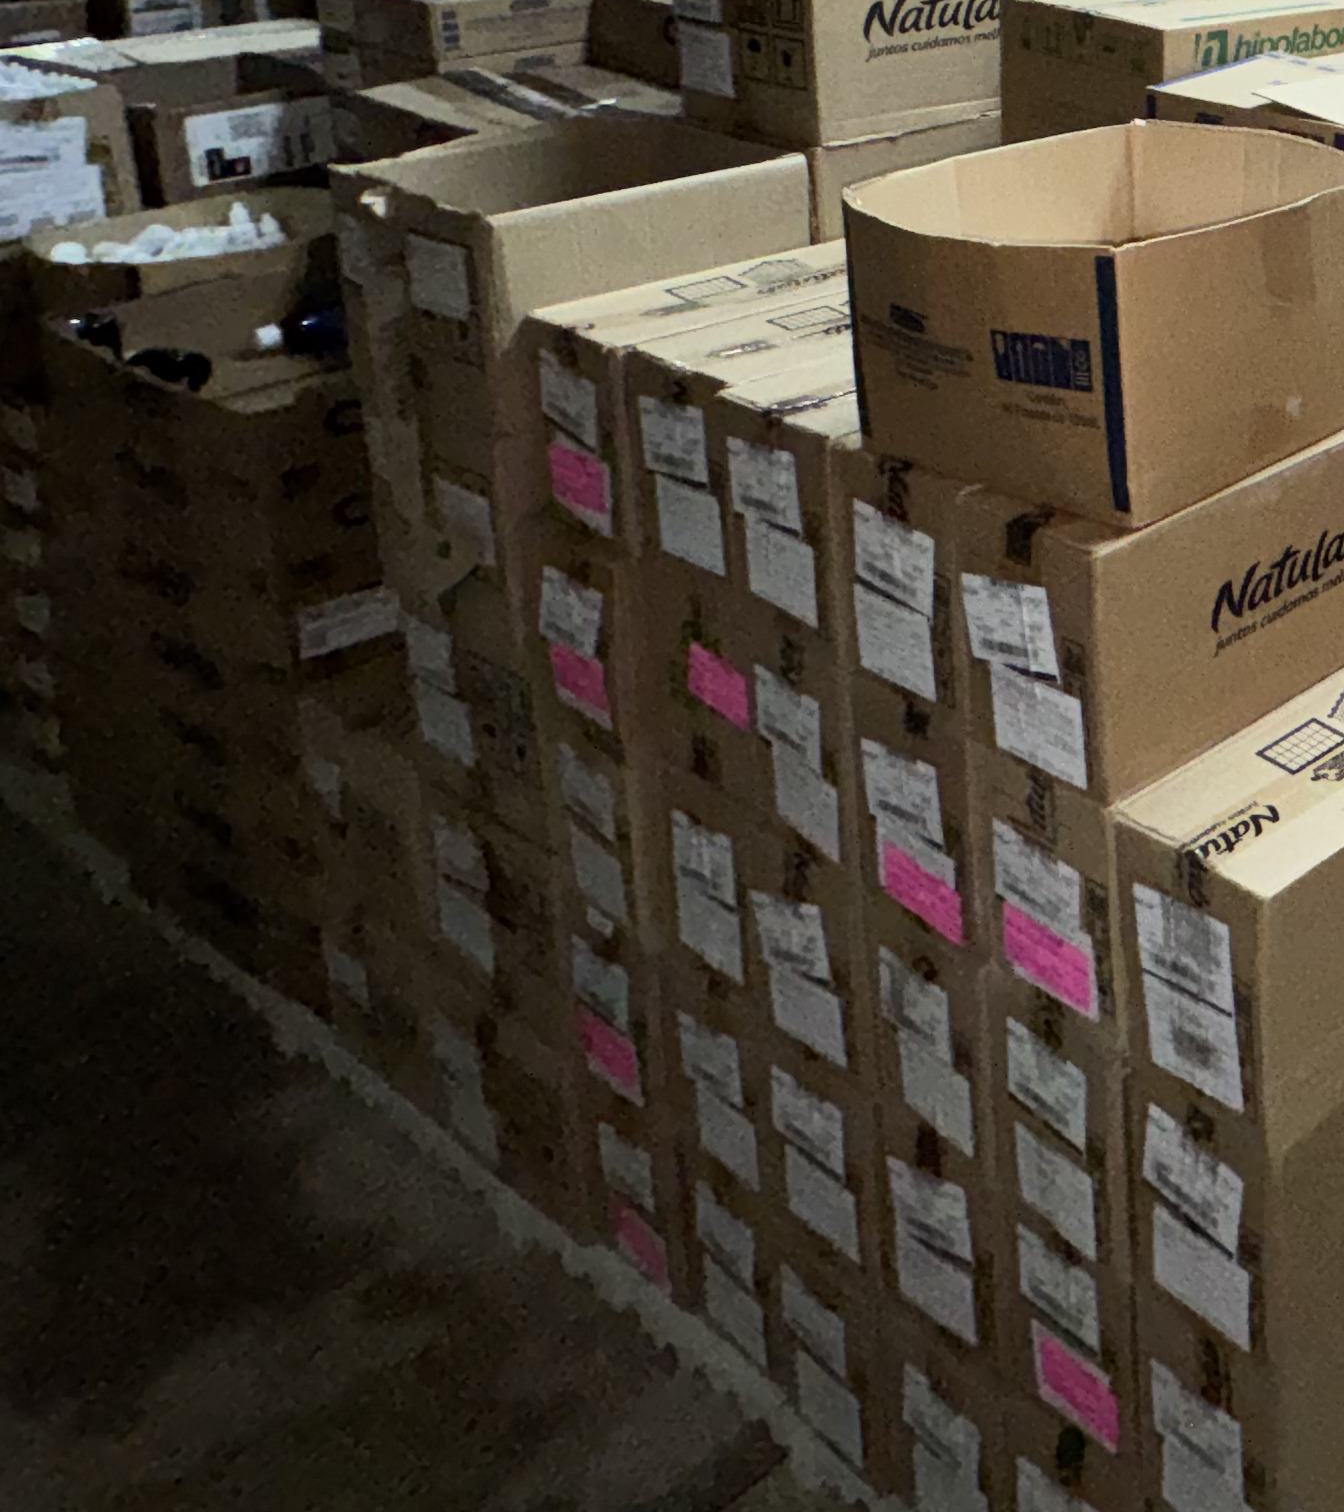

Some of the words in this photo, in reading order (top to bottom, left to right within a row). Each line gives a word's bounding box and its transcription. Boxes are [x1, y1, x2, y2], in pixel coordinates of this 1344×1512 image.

[865, 42, 909, 63] juntos
[912, 34, 971, 51] cuidamos
[1208, 621, 1257, 663] juntos
[1260, 587, 1319, 628] cuidamos
